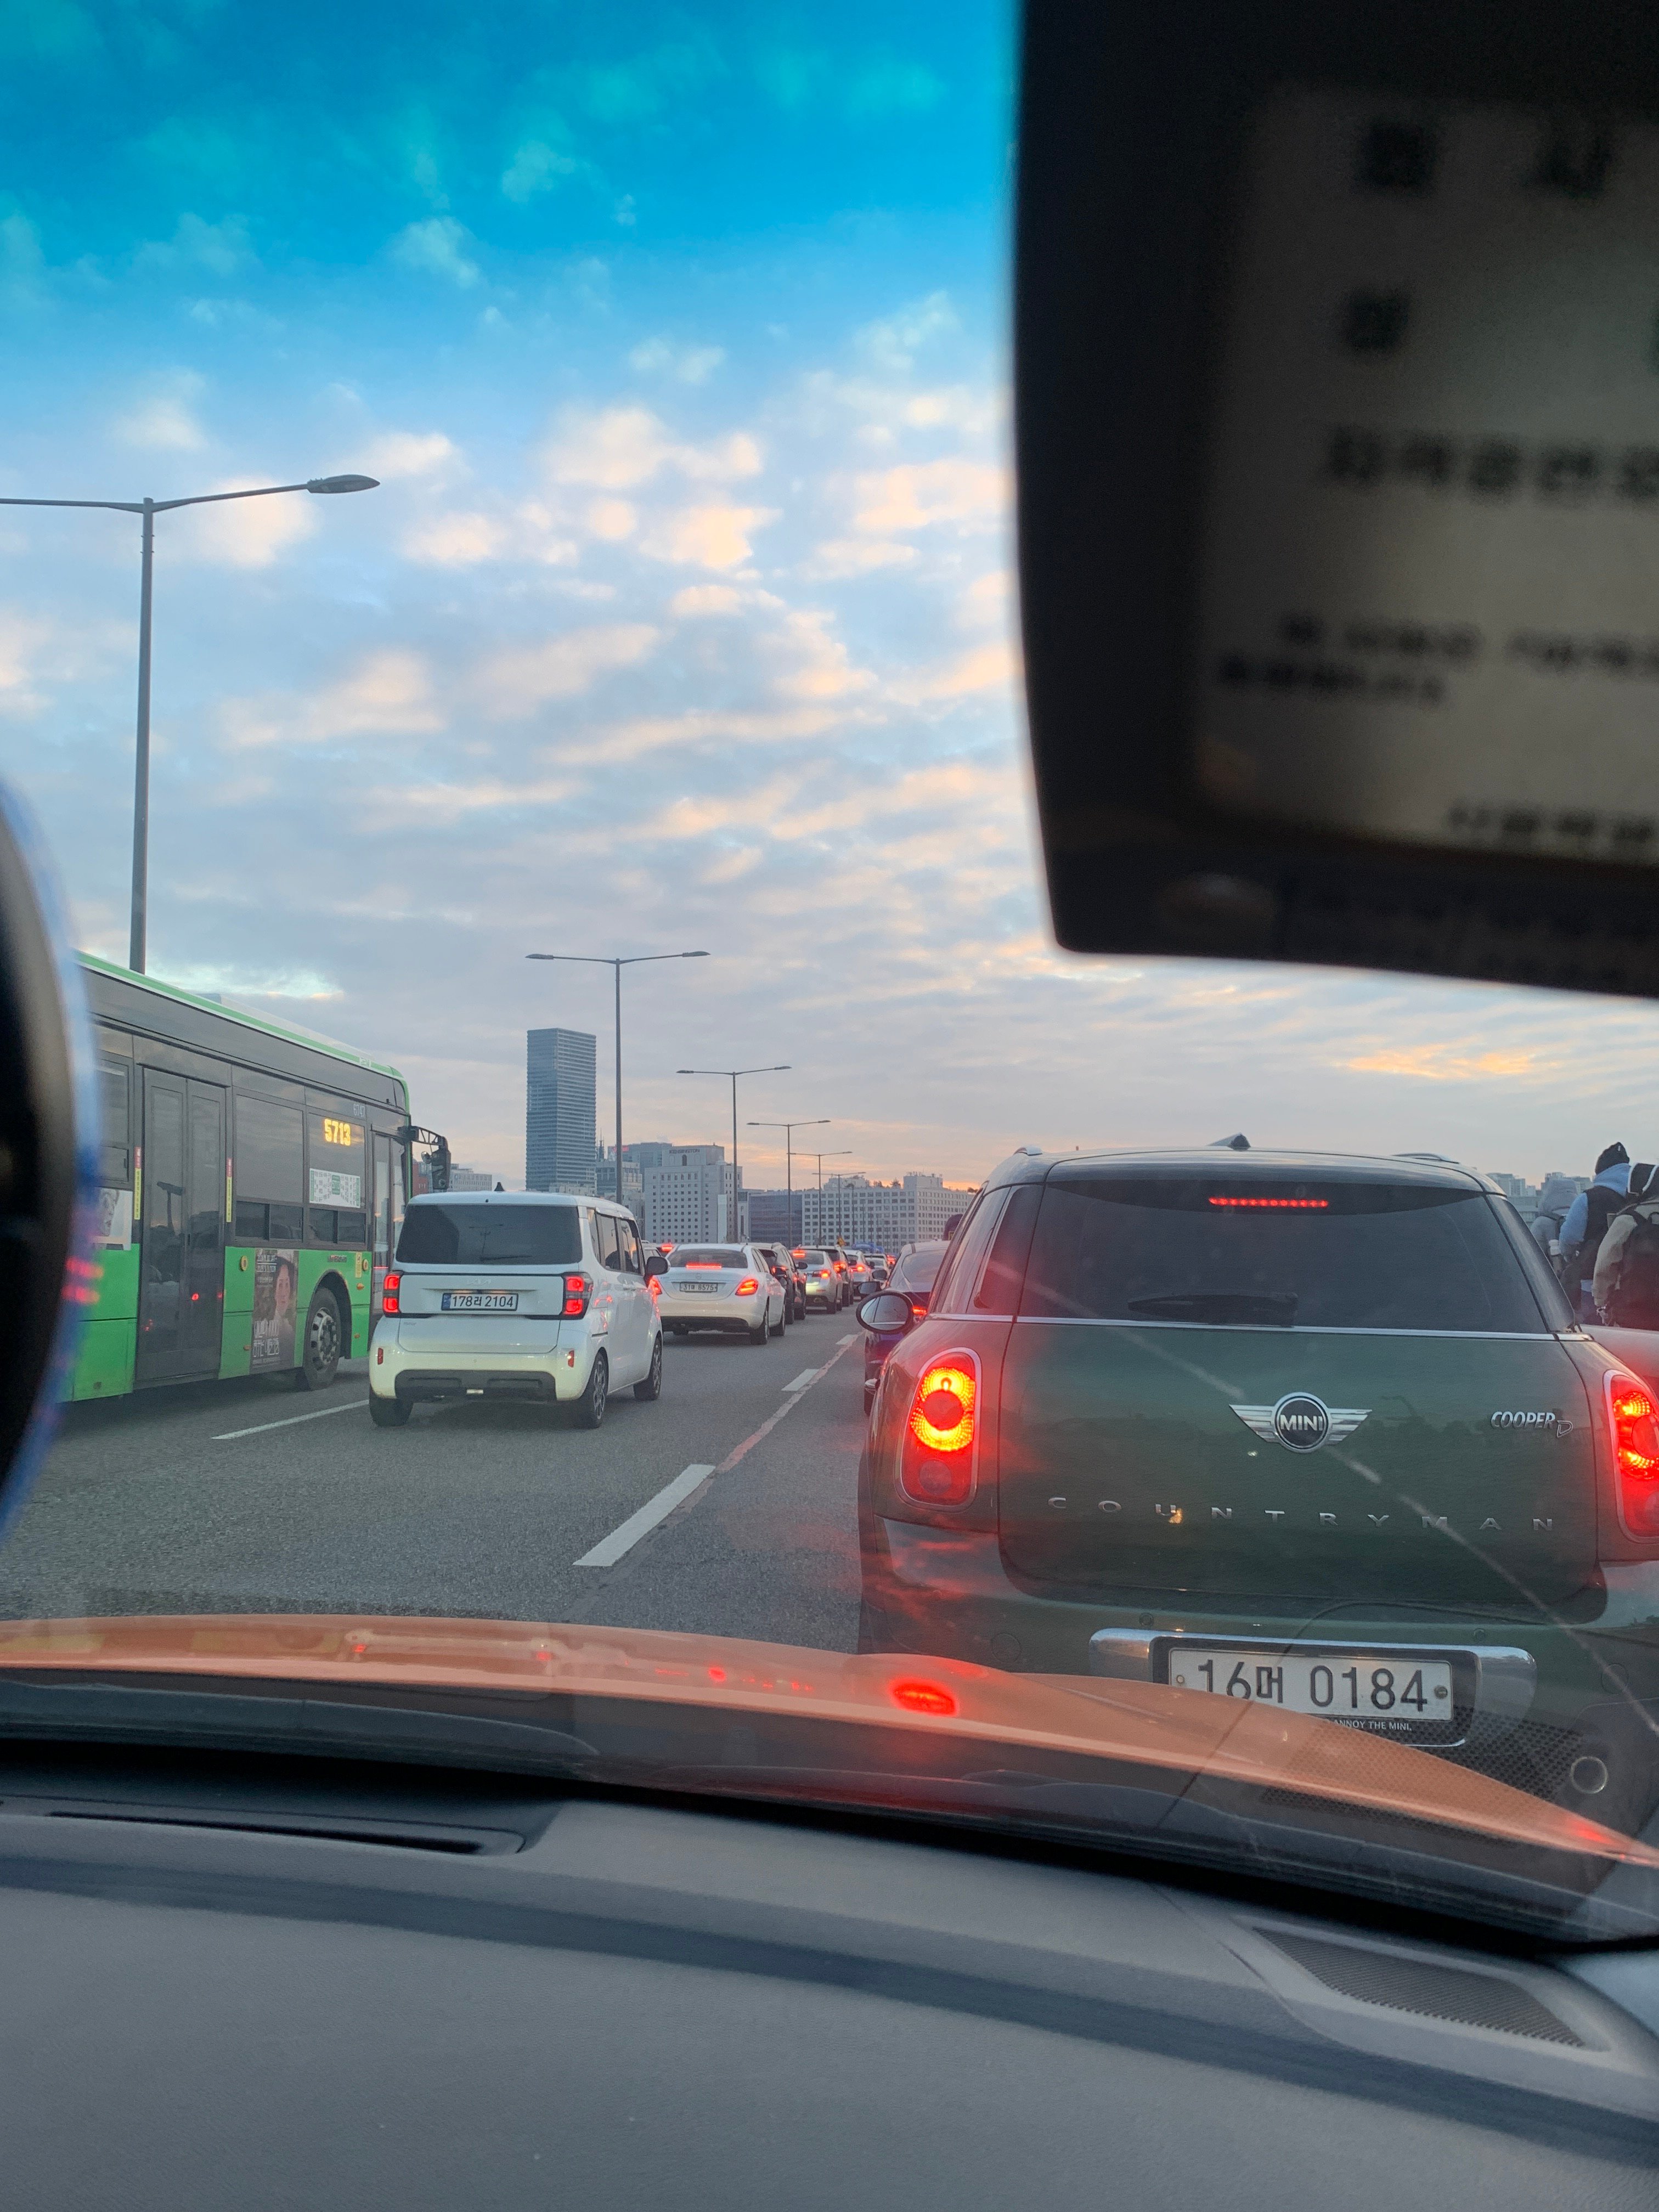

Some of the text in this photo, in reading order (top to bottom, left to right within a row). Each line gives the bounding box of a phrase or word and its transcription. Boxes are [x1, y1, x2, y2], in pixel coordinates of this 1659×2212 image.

[324, 1119, 351, 1146] 5713
[484, 1296, 514, 1307] 2104
[1280, 1414, 1323, 1431] MINI
[1491, 1411, 1556, 1428] COOPER
[1048, 1497, 1553, 1531] COUNTRYMAN
[1198, 1659, 1428, 1713] 16머 0184
[1368, 1722, 1387, 1730] THE
